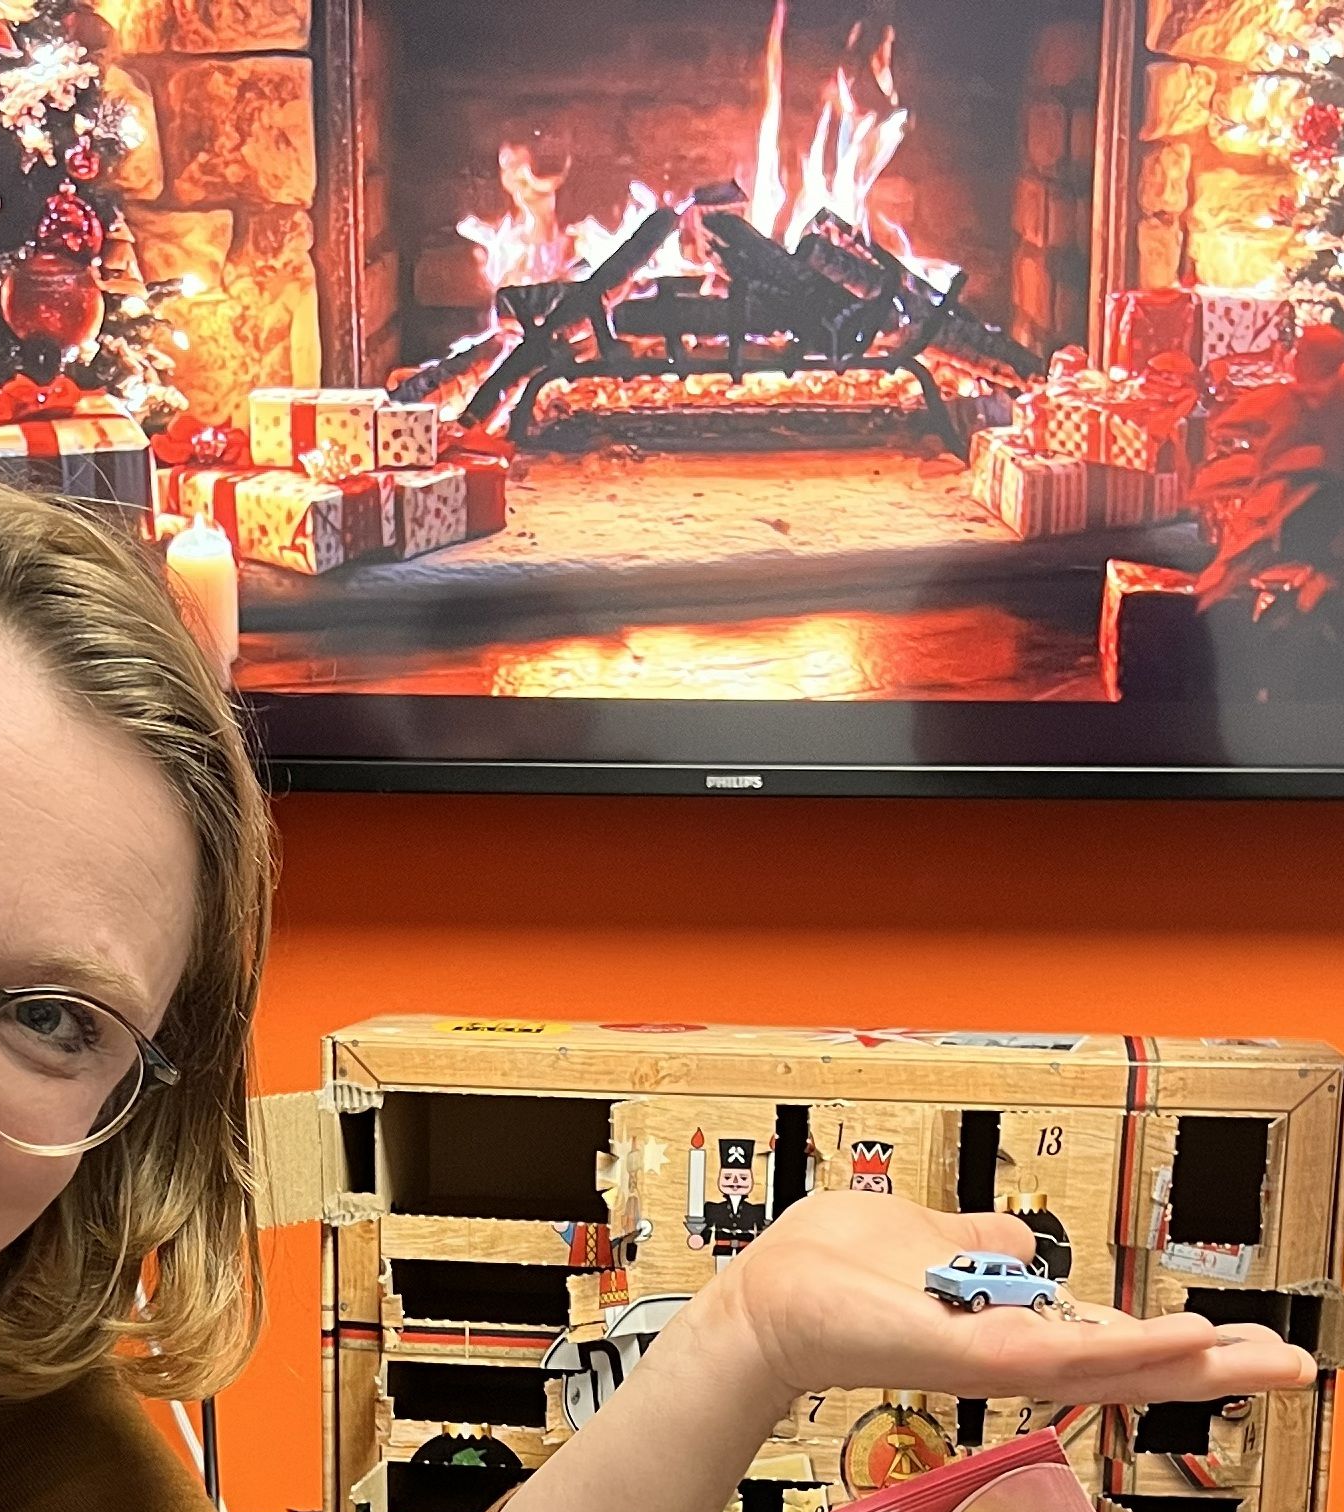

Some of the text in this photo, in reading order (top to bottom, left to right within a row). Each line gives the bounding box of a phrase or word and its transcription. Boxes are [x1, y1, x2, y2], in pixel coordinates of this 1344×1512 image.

[1036, 1126, 1063, 1156] 13
[808, 1395, 826, 1423] 7
[1015, 1407, 1032, 1435] 2
